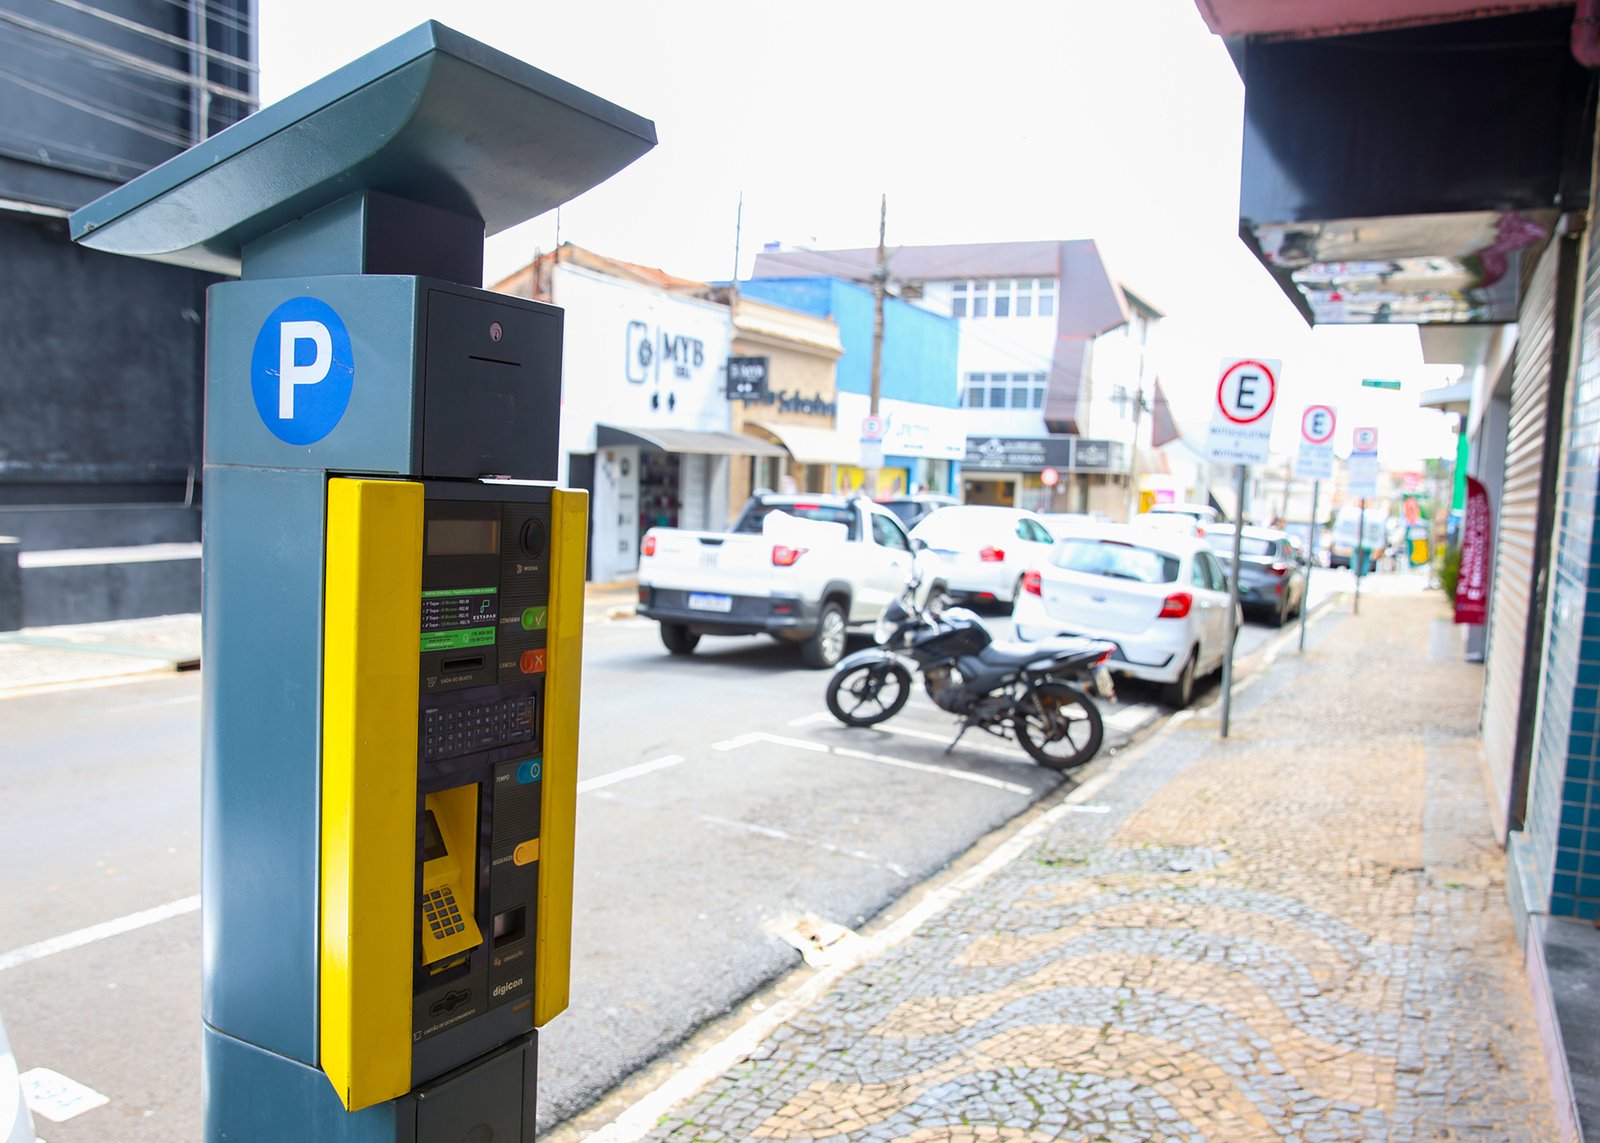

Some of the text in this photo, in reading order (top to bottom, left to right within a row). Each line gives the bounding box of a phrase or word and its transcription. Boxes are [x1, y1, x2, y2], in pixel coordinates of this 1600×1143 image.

[662, 331, 704, 369] MYB
[279, 320, 333, 419] P
[1236, 375, 1259, 410] E
[1312, 413, 1325, 435] E
[499, 661, 517, 669] CANCELA
[496, 774, 510, 782] TEMPO
[493, 978, 523, 997] digicon
